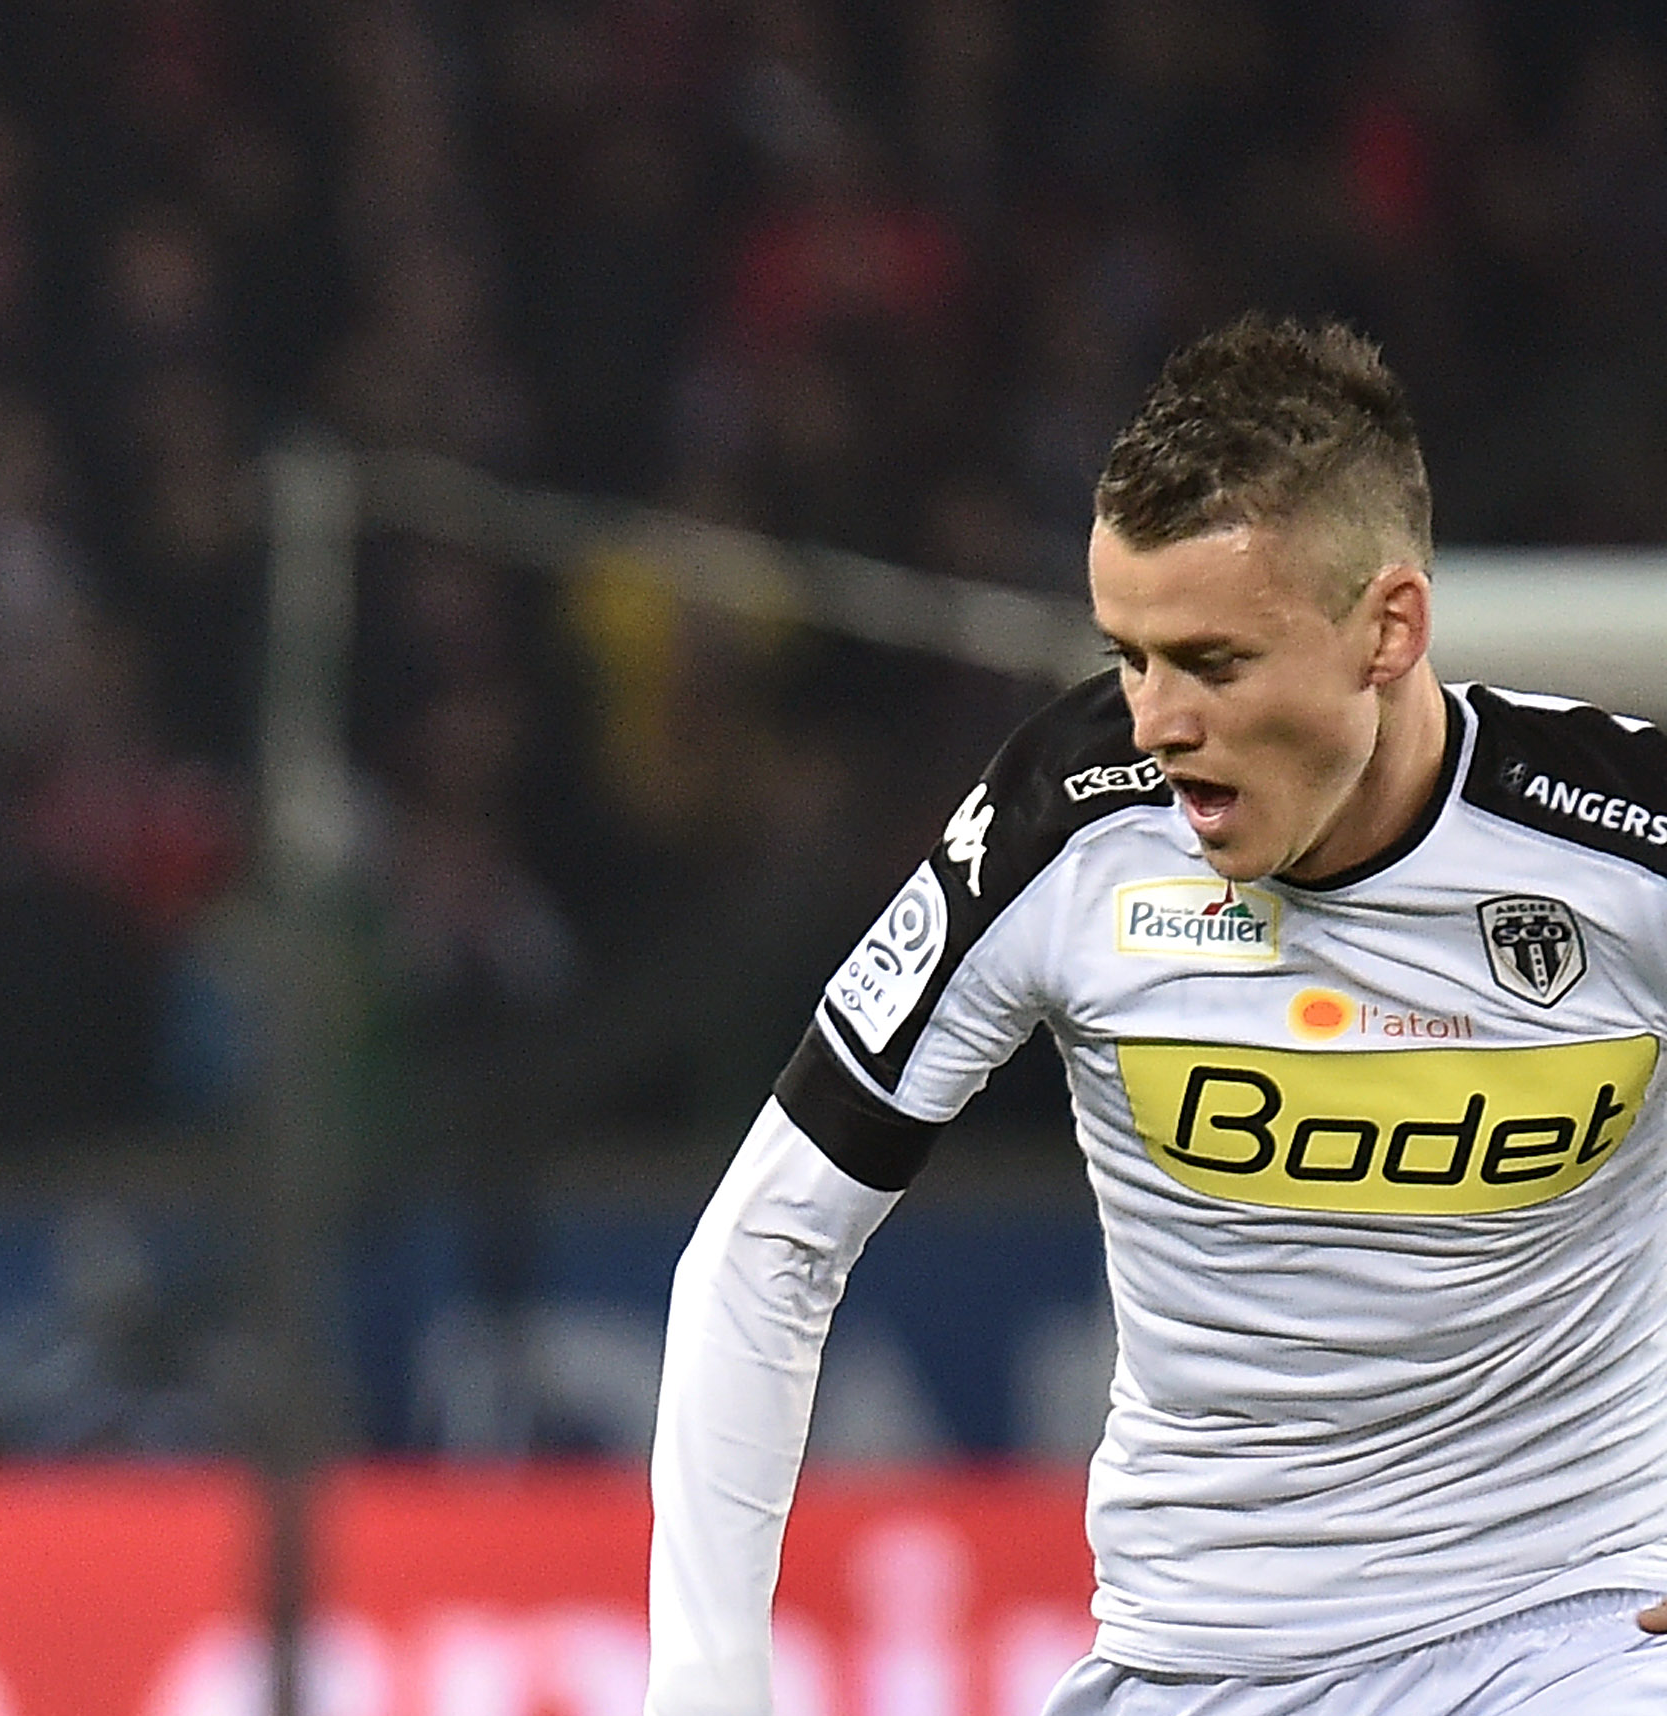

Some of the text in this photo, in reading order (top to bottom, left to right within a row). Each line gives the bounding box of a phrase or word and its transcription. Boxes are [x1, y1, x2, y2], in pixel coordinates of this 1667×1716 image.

[1065, 757, 1165, 801] Kap
[1524, 774, 1667, 845] ANGERS
[1128, 901, 1268, 946] Pasquier
[1498, 923, 1563, 944] SCO
[1360, 1003, 1472, 1039] l'atoll
[1164, 1065, 1625, 1185] Bodet
